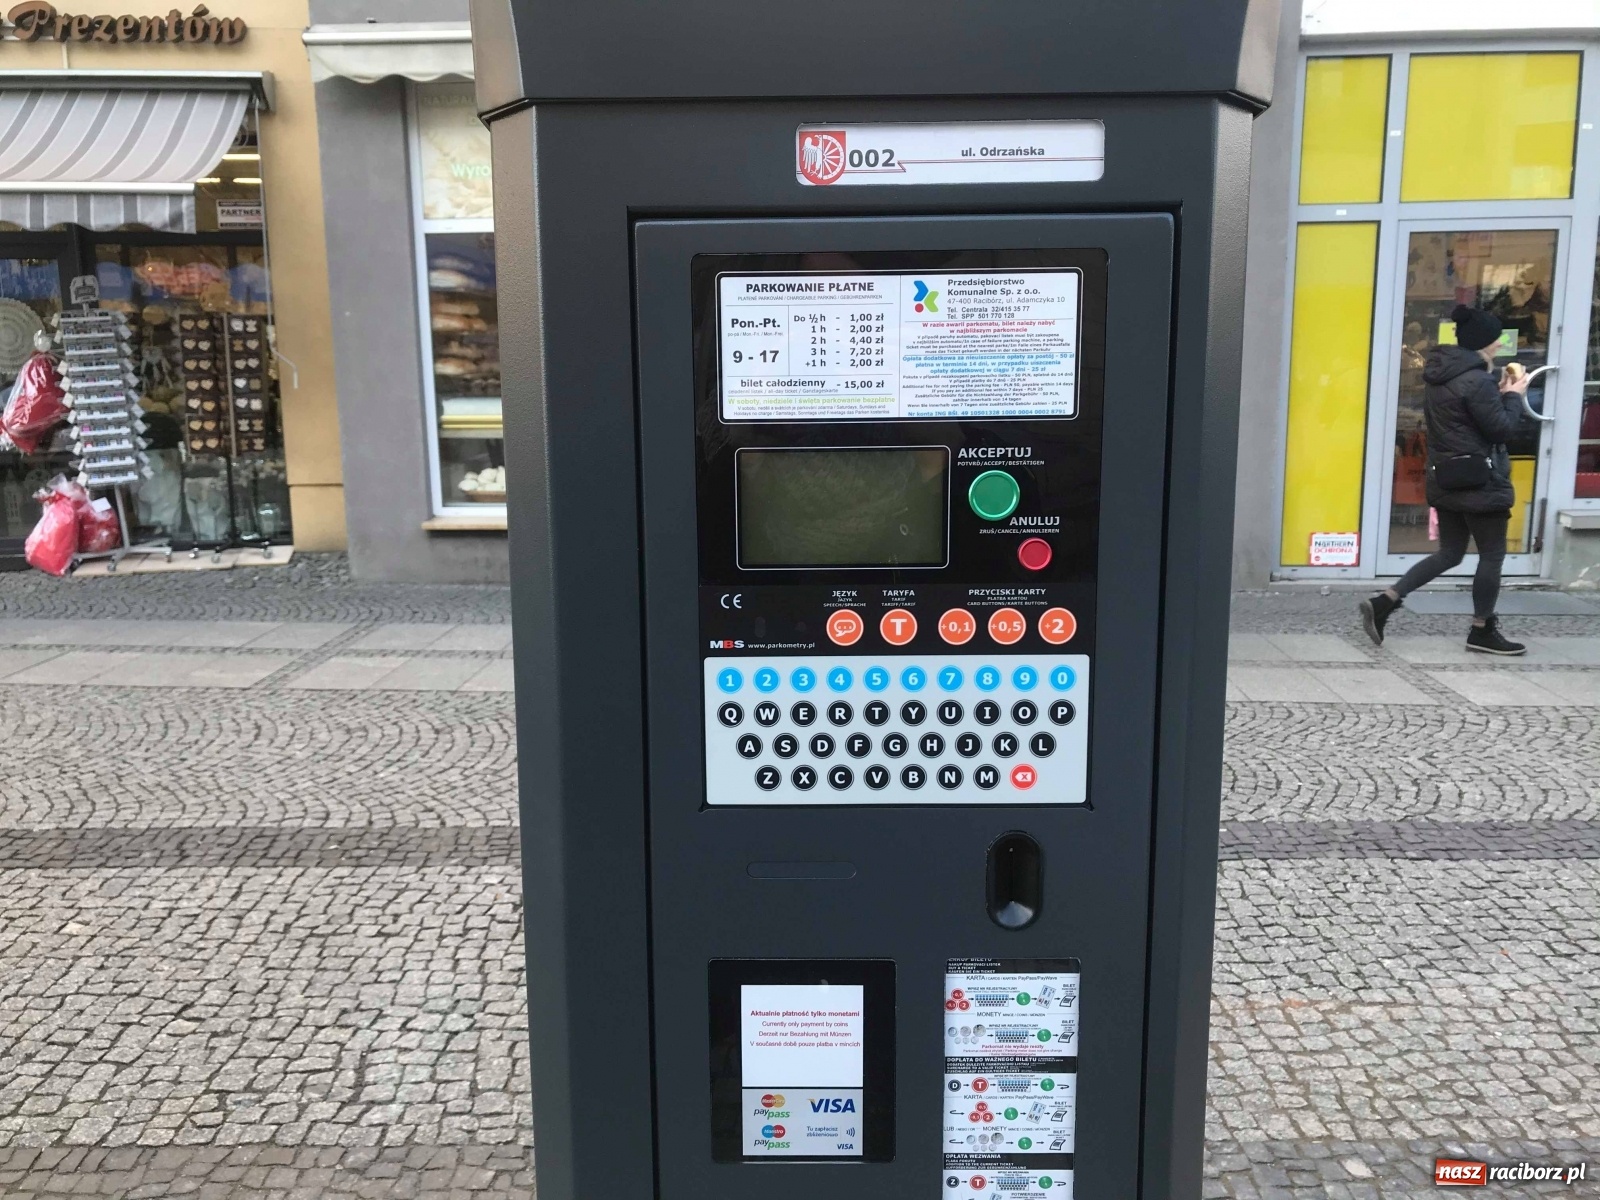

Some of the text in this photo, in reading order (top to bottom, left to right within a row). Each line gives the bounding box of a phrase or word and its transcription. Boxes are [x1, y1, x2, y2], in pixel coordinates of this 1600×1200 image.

[8, 1, 248, 44] Prezentów
[848, 146, 1045, 168] 002 ul. Odrzańska
[746, 282, 874, 293] PARKOWANIE PŁATNE
[948, 279, 1024, 287] Przedsiębiorstwo
[731, 318, 780, 328] Pon.-Pt.
[850, 313, 872, 323] 1,00
[875, 313, 884, 321] zł
[850, 325, 872, 334] 2,00
[850, 336, 872, 345] 4,40
[733, 350, 779, 363] 9 17
[850, 348, 872, 357] 7,20
[850, 359, 872, 368] 2,00
[875, 358, 884, 366] zł
[741, 379, 763, 387] bilet
[766, 379, 826, 388] całodzienny
[845, 380, 872, 390] 15,00
[958, 447, 1032, 458] AKCEPTUJ
[1009, 516, 1060, 526] ANULUJ
[890, 619, 907, 636] T
[941, 622, 971, 634] +0,1
[991, 621, 1022, 634] +0,5
[1045, 618, 1064, 634] +2
[710, 640, 745, 649] MBS
[726, 672, 1068, 687] 1 2 3 4 5 6 7 8 9 0
[724, 707, 1068, 723] Q W E R T Y U I O P
[744, 739, 1047, 752] A S D F G H J K L
[763, 771, 994, 784] Z X C V B N M
[808, 1099, 855, 1113] VISA
